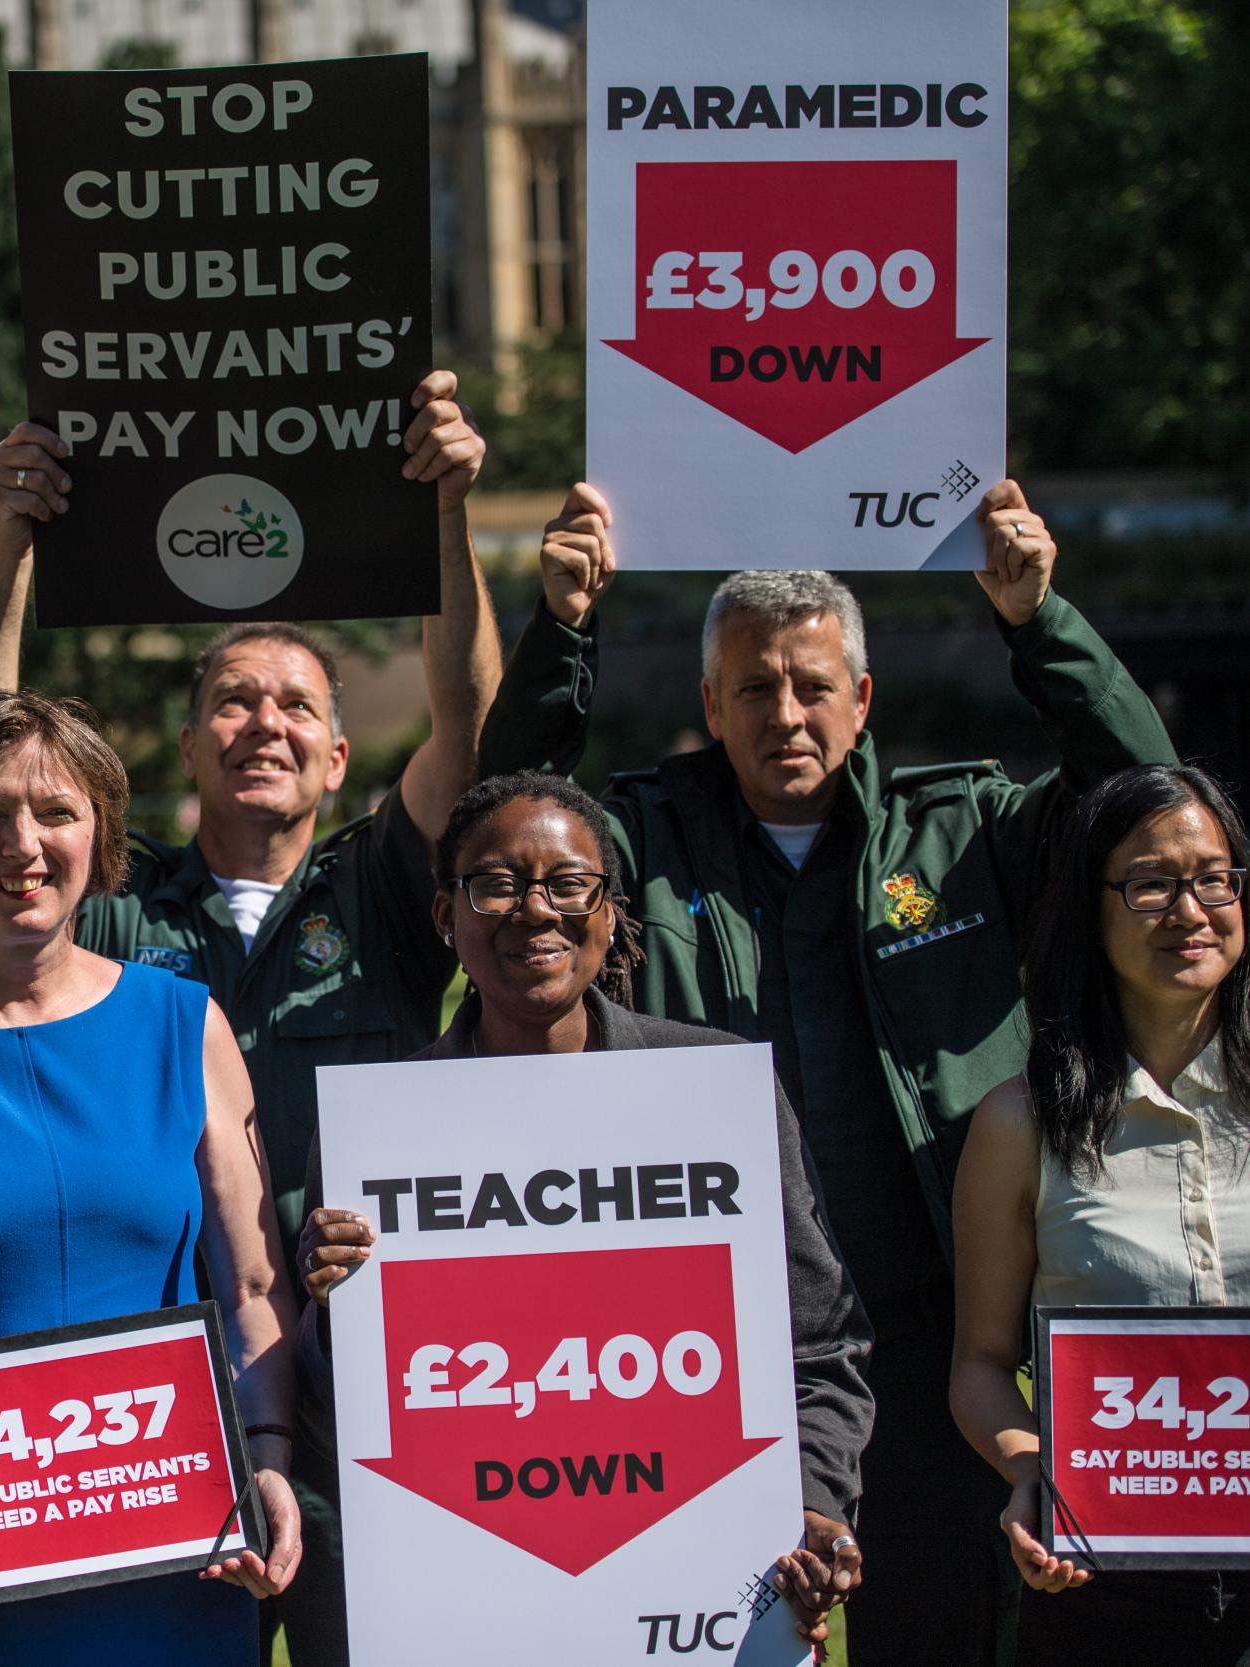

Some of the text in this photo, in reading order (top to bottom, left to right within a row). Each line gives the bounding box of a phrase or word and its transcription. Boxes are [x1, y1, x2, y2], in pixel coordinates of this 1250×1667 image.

[125, 80, 312, 136] STOP
[608, 83, 988, 130] PARAMEDIC
[65, 159, 378, 218] CUTTING
[100, 243, 350, 299] PUBLIC
[647, 250, 935, 321] £3,900
[42, 317, 411, 378] SERVANTS'
[711, 346, 881, 382] DOWN
[59, 399, 400, 456] PAY NOW!
[849, 492, 940, 527] TUC
[168, 529, 289, 558] care2
[138, 950, 189, 971] NHS
[362, 1162, 742, 1233] TEACHER
[403, 1331, 721, 1418] £2,400
[78, 1453, 210, 1489] SERVANTS
[475, 1452, 663, 1501] DOWN
[1070, 1450, 1120, 1468] SAY
[1127, 1450, 1218, 1469] PUBLIC
[45, 1503, 64, 1522] A
[67, 1493, 114, 1518] PAY
[121, 1484, 178, 1509] RISE
[1110, 1476, 1178, 1494] NEED
[1184, 1477, 1204, 1494] A
[638, 1612, 737, 1654] TUC
